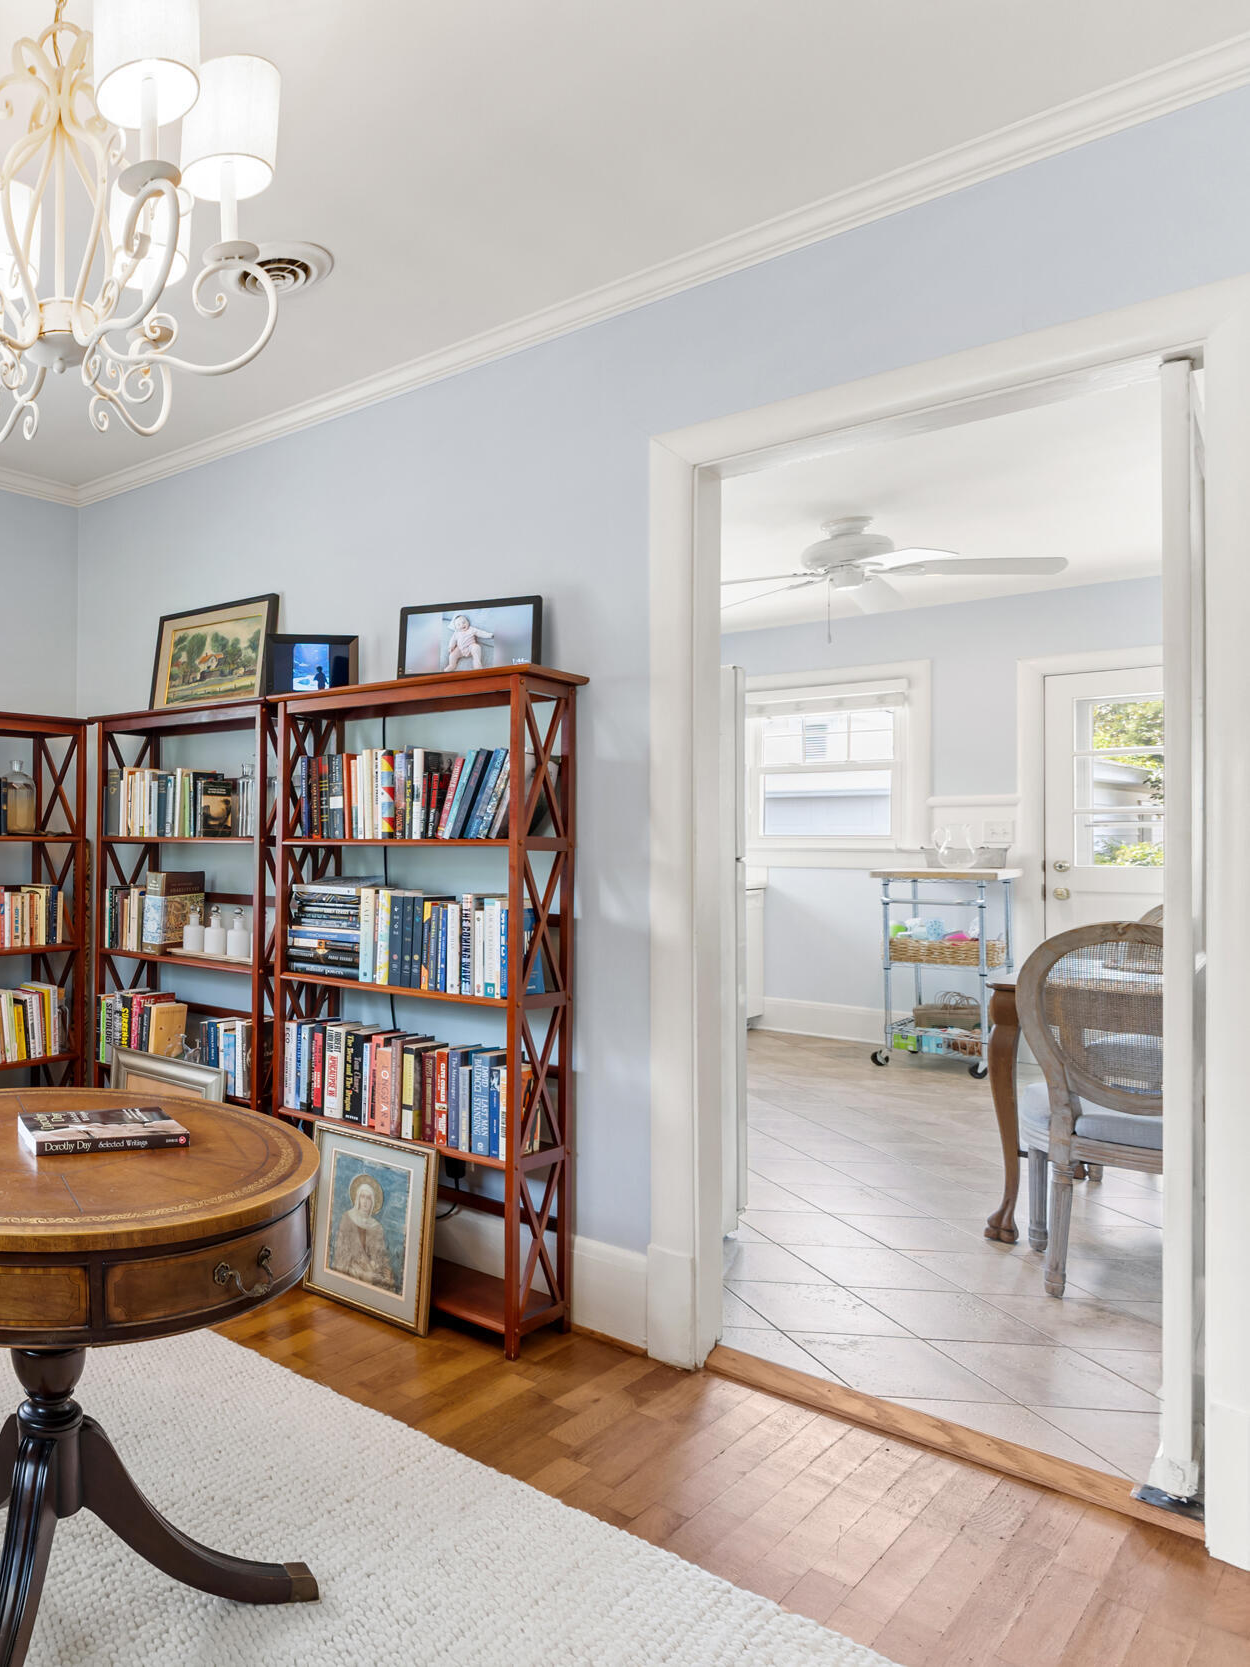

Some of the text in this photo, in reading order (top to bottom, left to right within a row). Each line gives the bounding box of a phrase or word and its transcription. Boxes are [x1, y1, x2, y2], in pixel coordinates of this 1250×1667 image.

[461, 907, 471, 986] THE COMING WAVE
[354, 1057, 362, 1070] Tom
[481, 1119, 489, 1137] MAN
[45, 1138, 149, 1152] Dorothy Day Selected Writings
